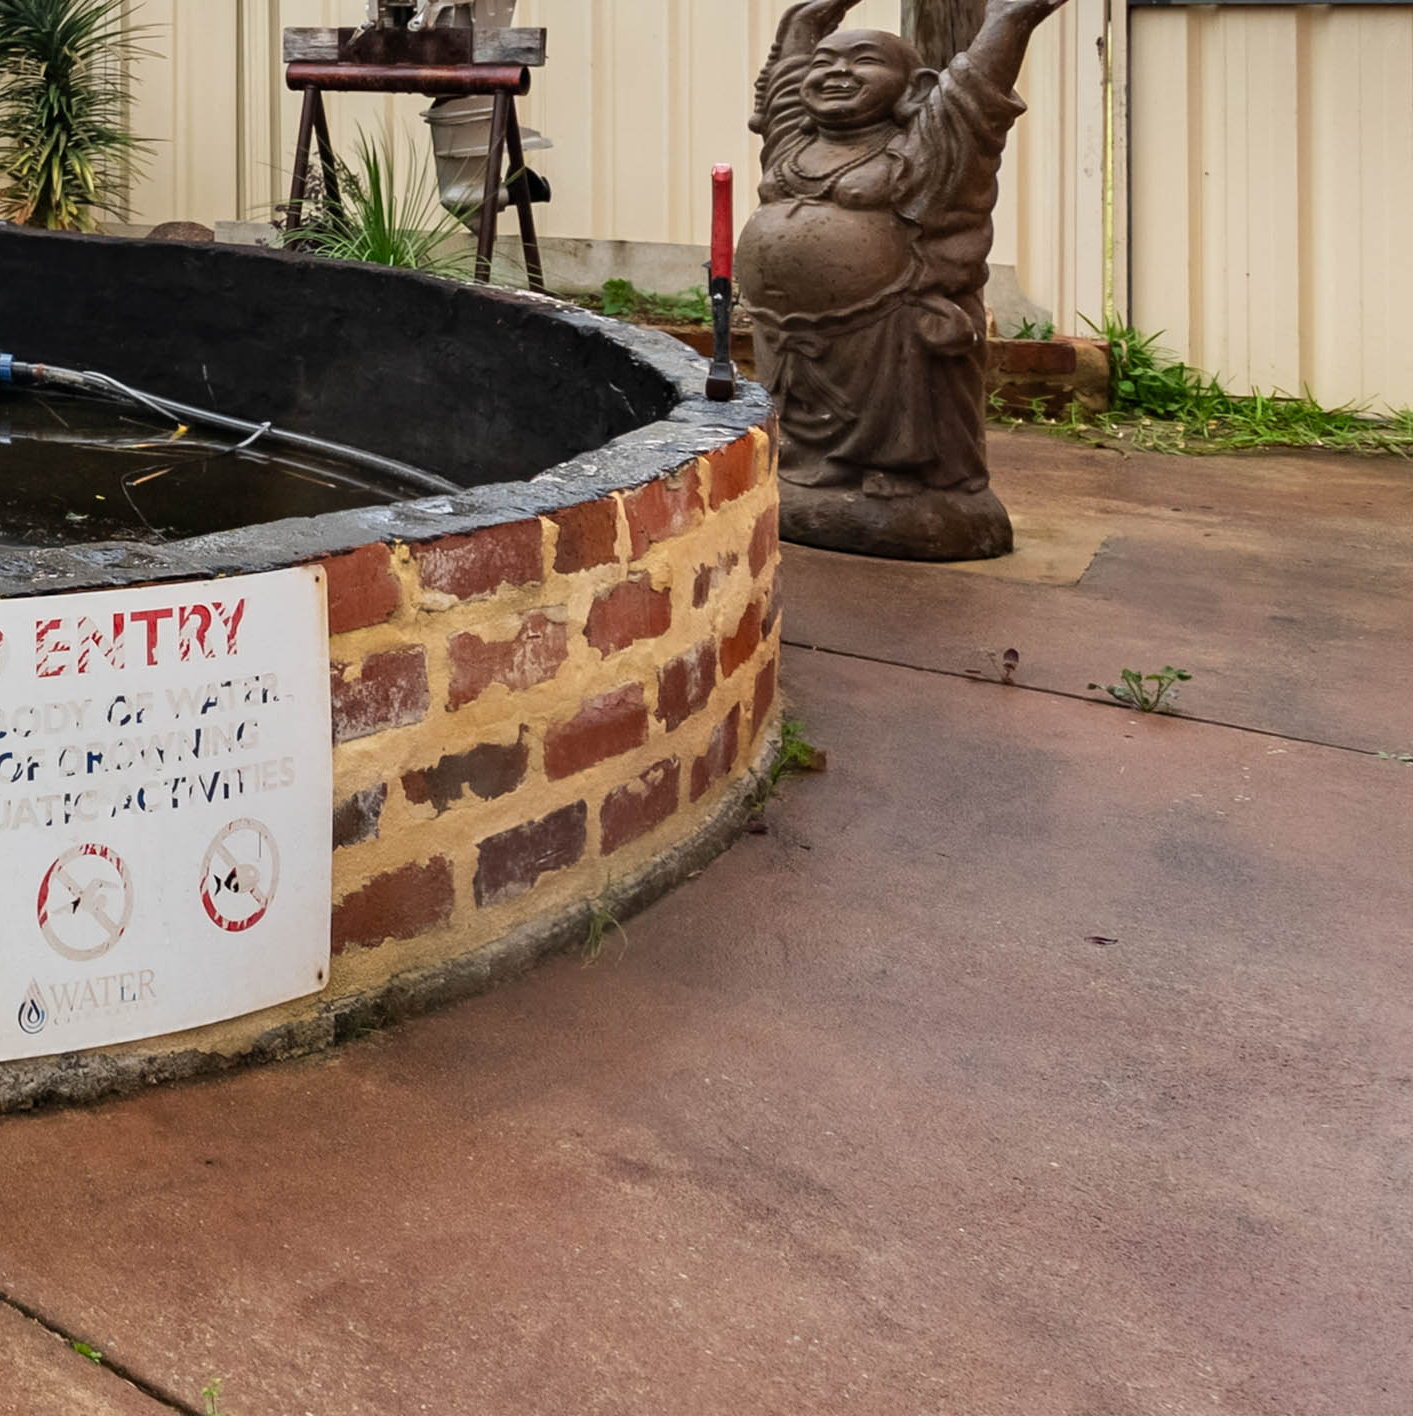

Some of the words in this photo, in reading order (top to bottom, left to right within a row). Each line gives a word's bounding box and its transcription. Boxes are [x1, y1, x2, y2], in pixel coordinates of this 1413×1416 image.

[35, 598, 246, 679] ENTRY
[107, 691, 153, 726] OF
[165, 672, 279, 719] WATER
[58, 720, 259, 777] DROWNING
[111, 757, 294, 817] ACTIVITIES
[49, 969, 157, 1014] WATER
